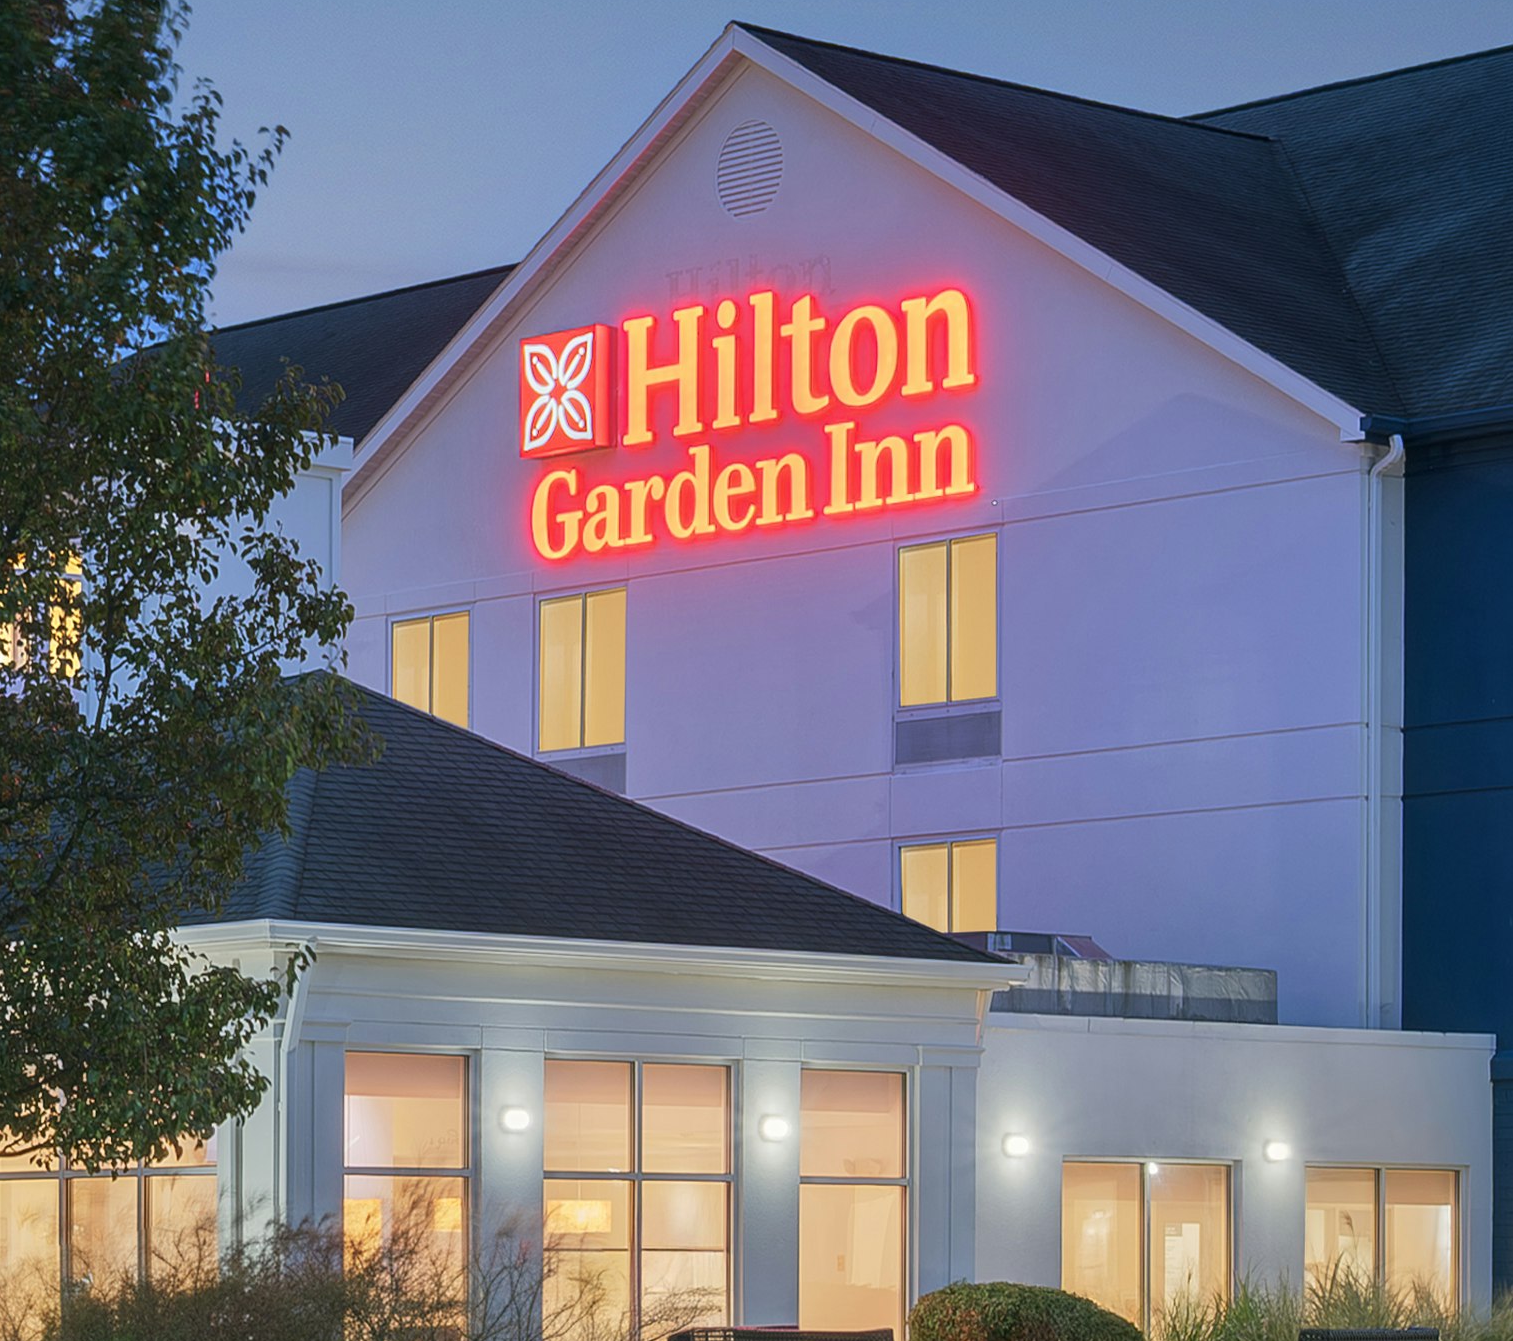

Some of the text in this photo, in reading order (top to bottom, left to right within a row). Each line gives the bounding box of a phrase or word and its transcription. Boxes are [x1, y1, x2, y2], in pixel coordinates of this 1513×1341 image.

[622, 288, 975, 446] Hilton
[532, 421, 975, 560] Garden Inn
